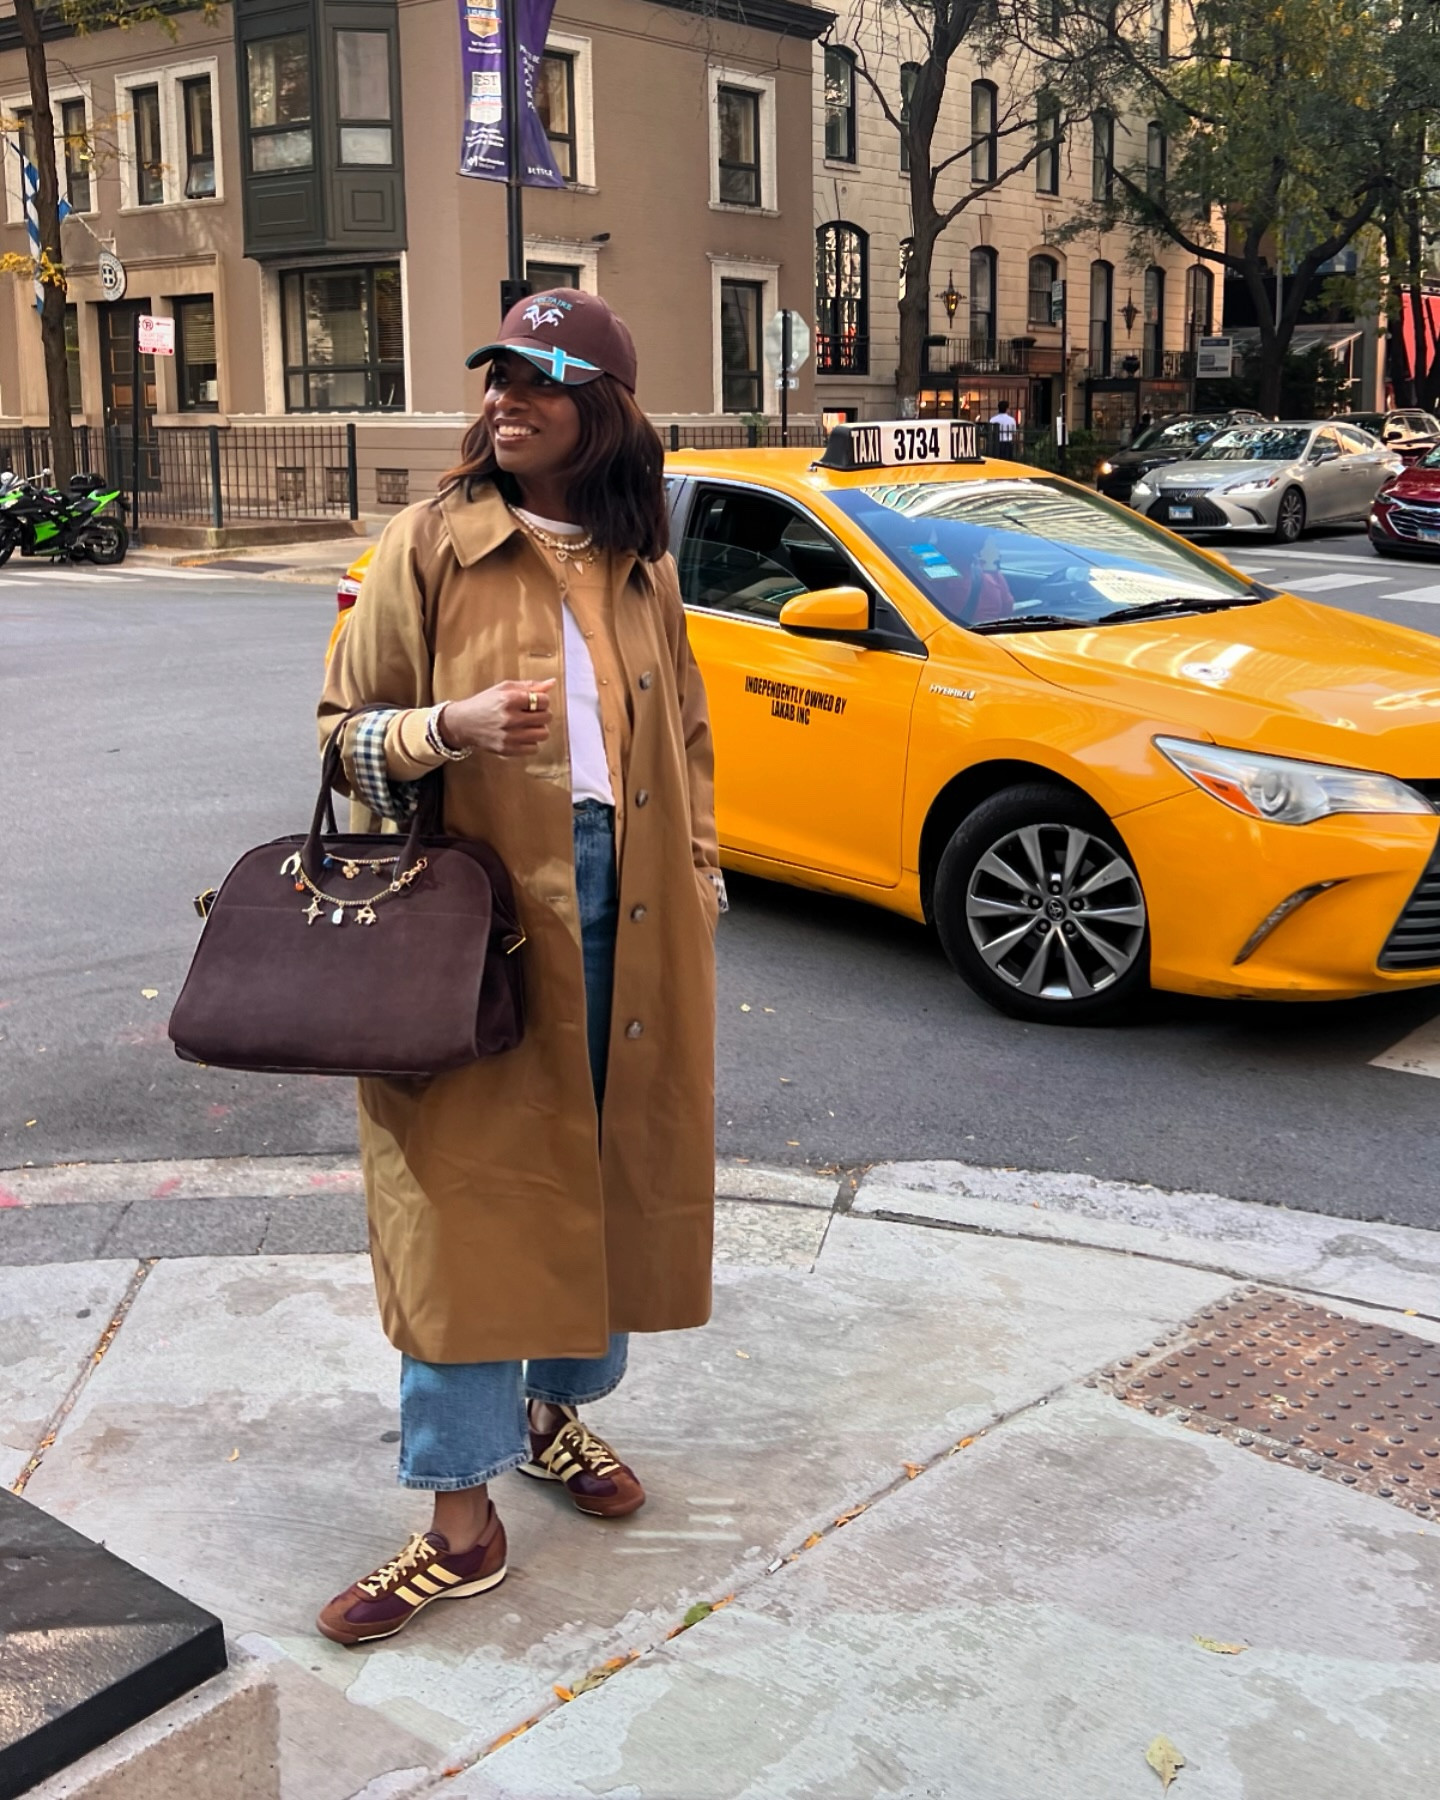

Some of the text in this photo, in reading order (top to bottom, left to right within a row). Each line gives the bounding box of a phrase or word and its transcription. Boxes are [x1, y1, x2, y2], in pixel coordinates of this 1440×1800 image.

[850, 426, 977, 464] TAXI 3734 TAXI
[744, 675, 848, 715] INDEPENDENTLY OWNED BY
[771, 699, 811, 726] LAKAB INC
